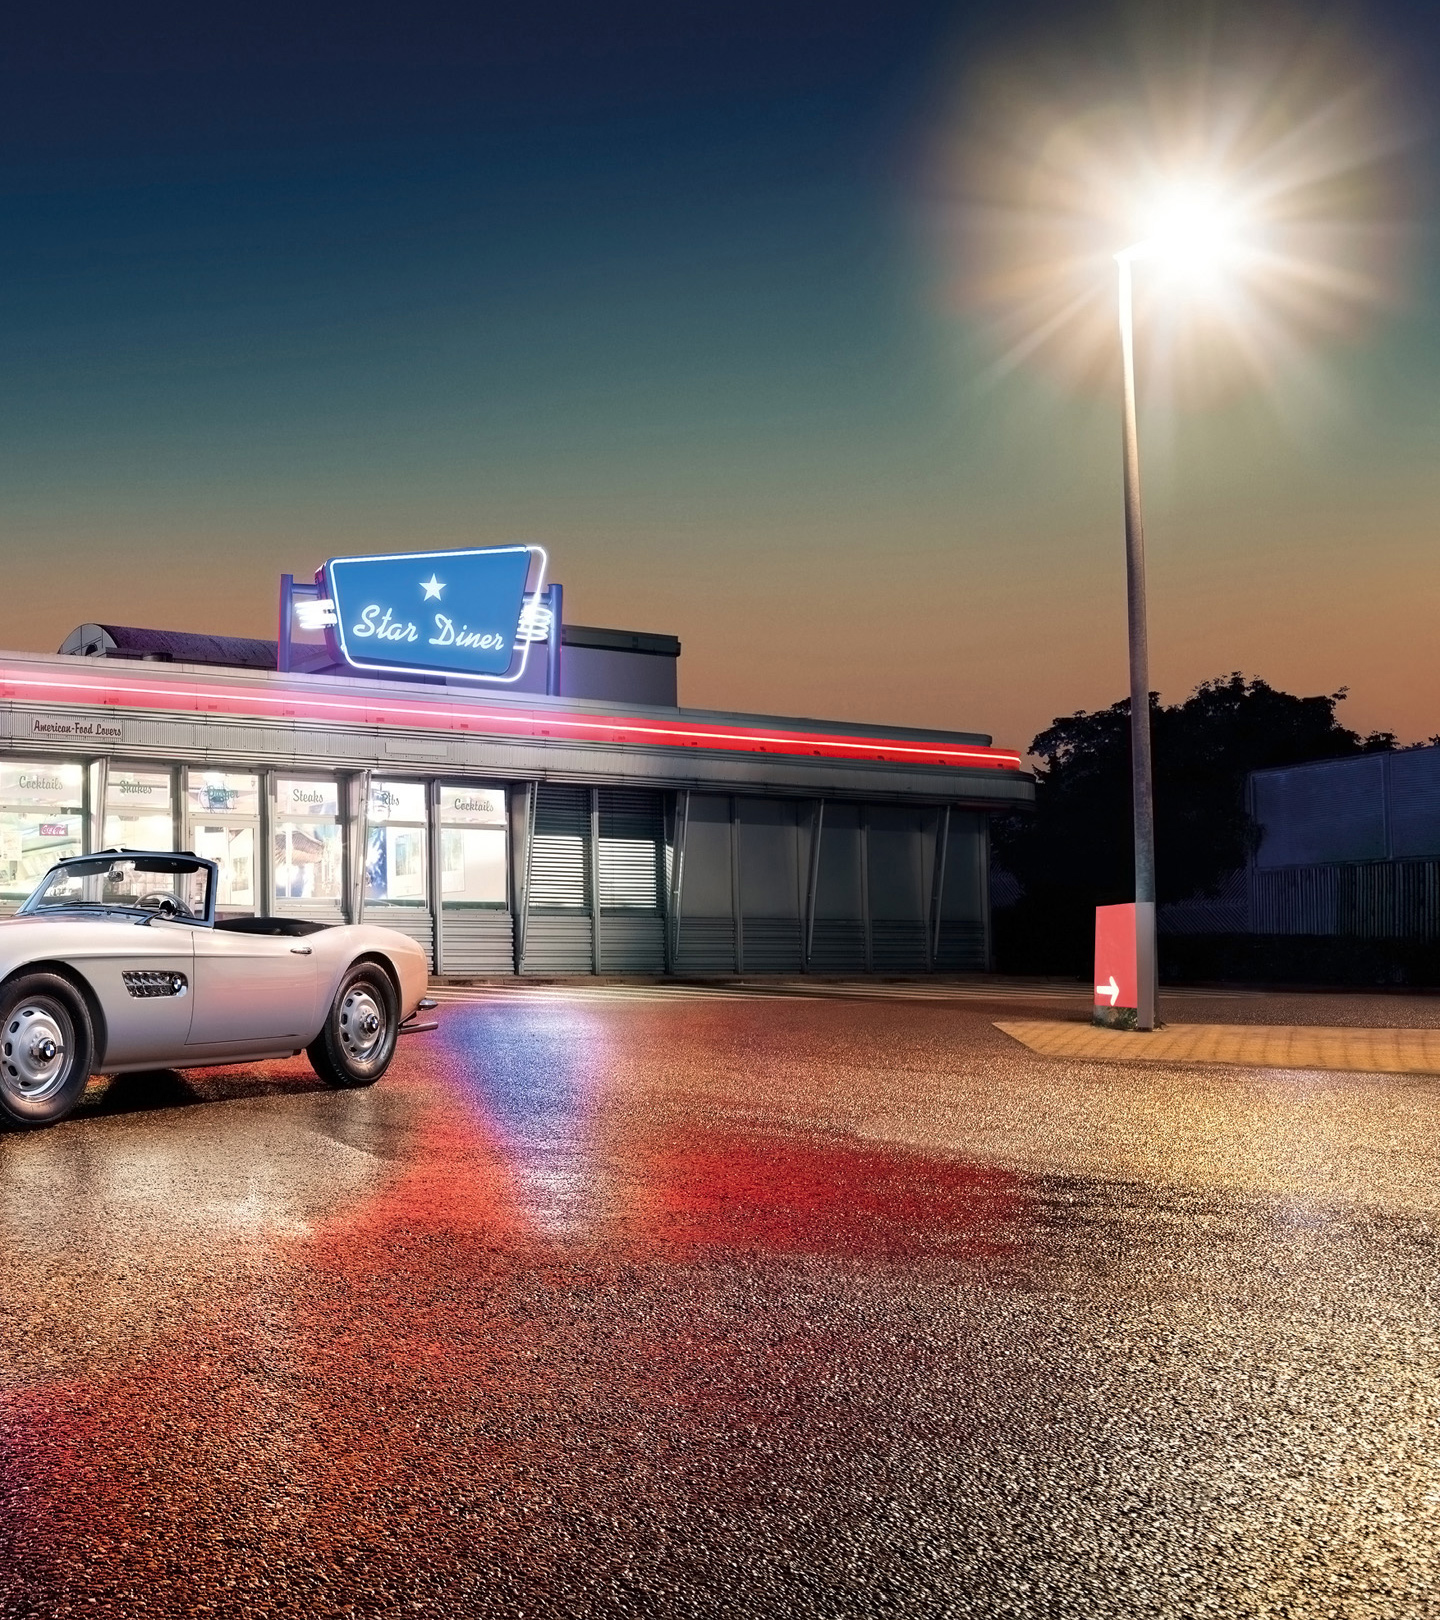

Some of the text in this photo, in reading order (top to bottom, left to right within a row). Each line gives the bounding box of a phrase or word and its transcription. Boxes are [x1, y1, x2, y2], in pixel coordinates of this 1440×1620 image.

[353, 604, 504, 651] Star Diner
[34, 720, 122, 737] American-Food Lovers
[19, 775, 64, 790] Cocktails
[120, 780, 152, 794] Shakes
[292, 788, 324, 803] Steaks
[454, 798, 494, 812] Cocktails
